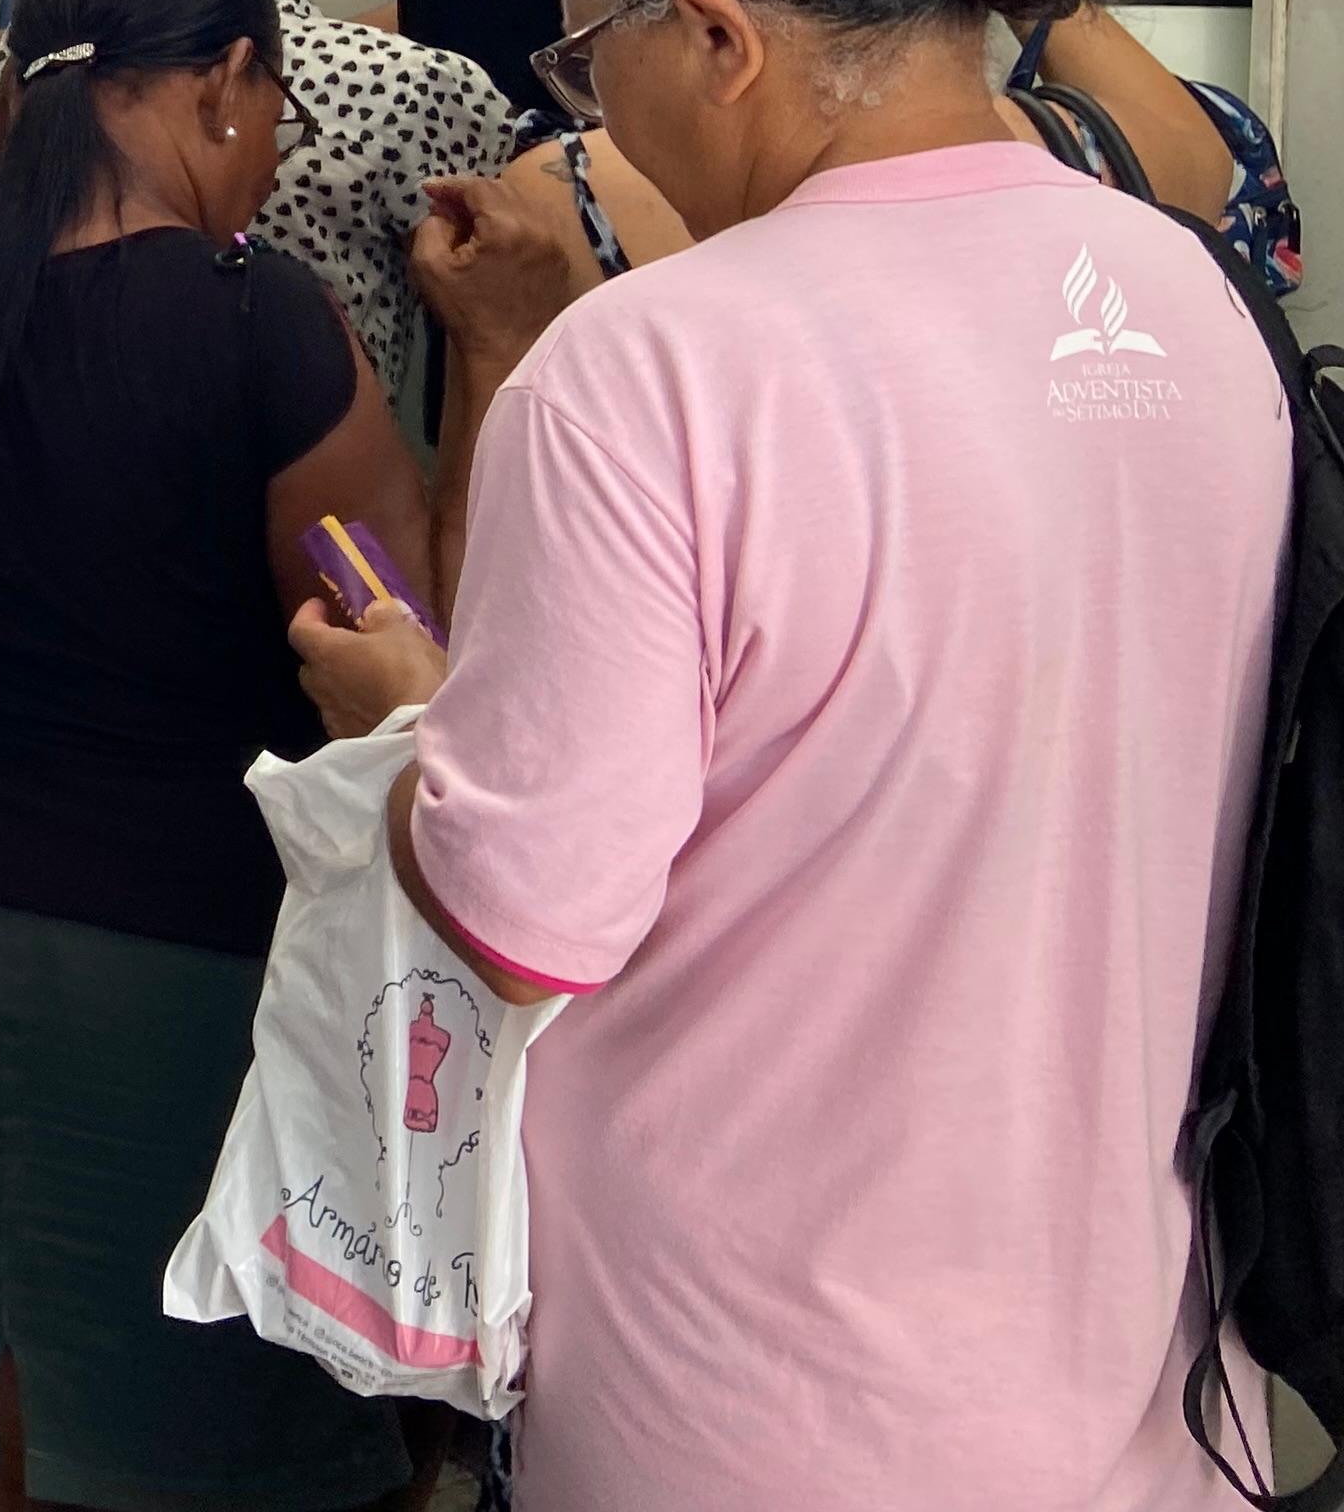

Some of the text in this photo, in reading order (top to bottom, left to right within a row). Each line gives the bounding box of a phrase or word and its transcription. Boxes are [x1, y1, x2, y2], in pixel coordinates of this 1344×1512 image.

[1082, 362, 1132, 378] IGREJA
[1047, 379, 1183, 407] ADVENTISTA
[414, 1258, 441, 1307] de
